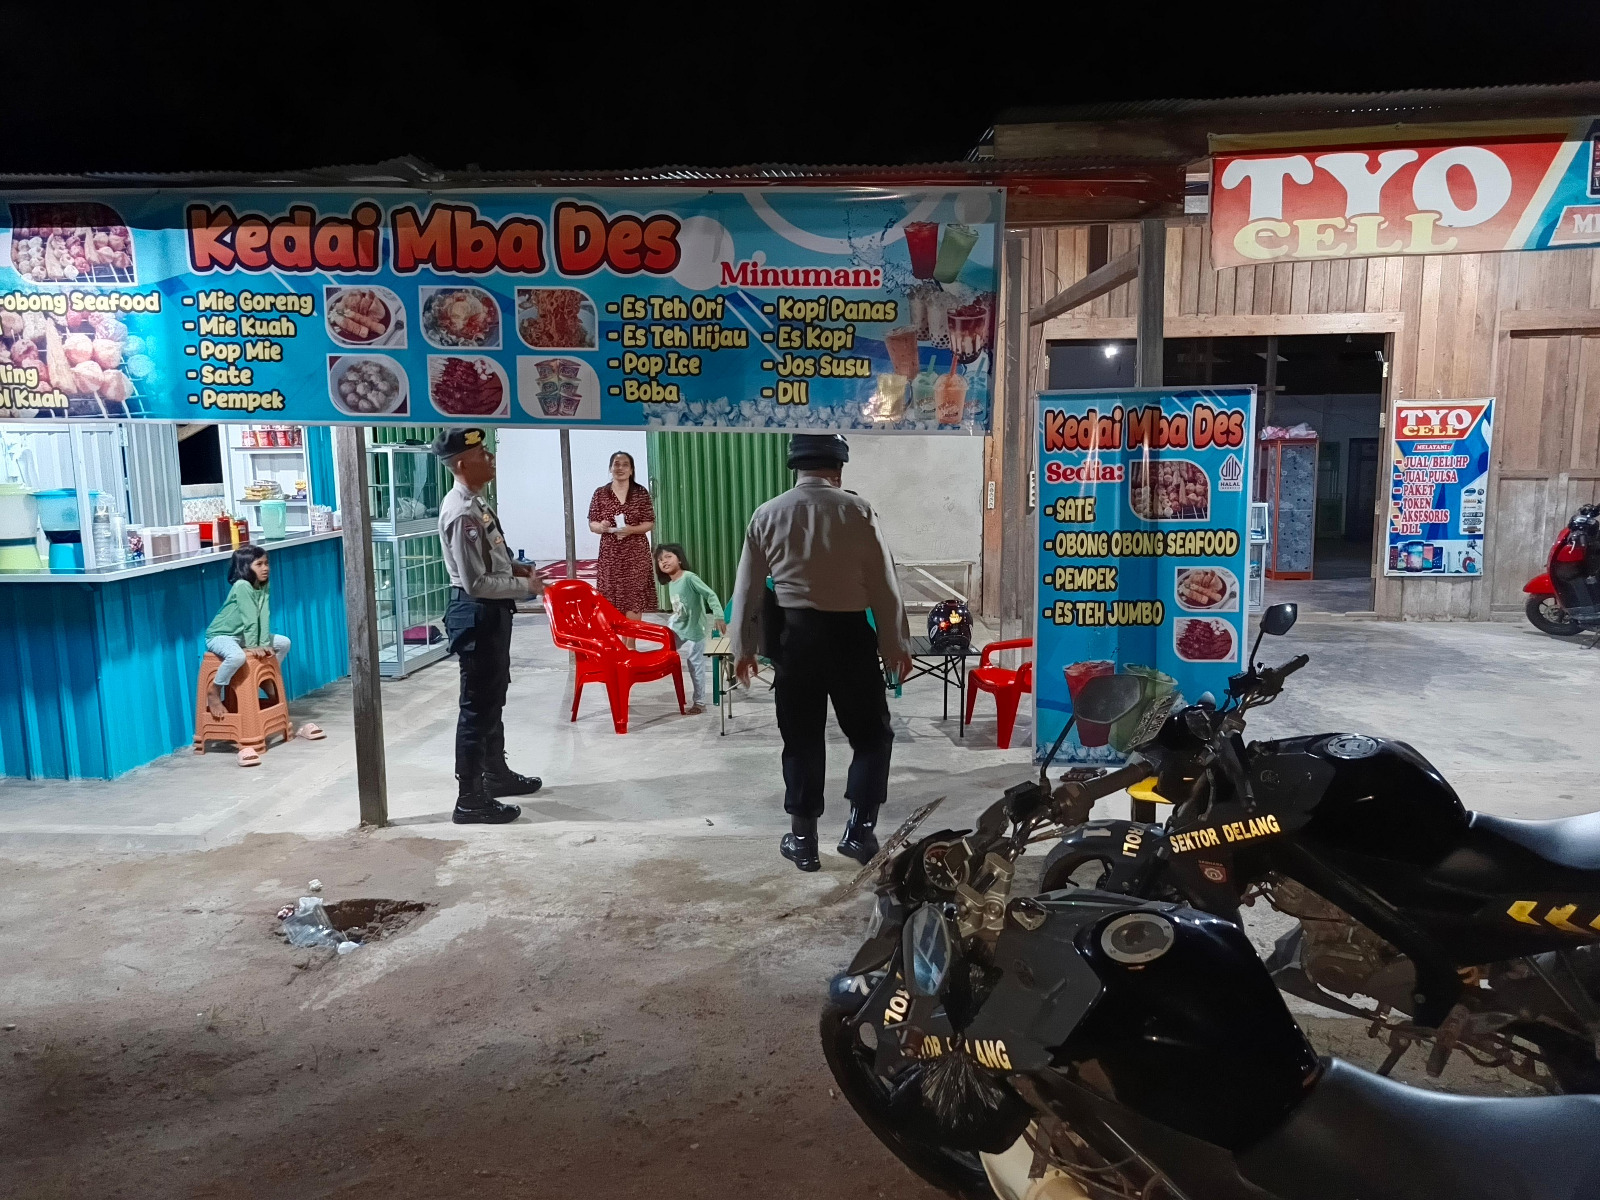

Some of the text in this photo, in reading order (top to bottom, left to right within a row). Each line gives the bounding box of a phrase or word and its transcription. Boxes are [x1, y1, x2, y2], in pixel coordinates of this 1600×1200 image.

[1221, 146, 1512, 236] TYO
[188, 202, 682, 274] Kedai Mba Des
[1233, 213, 1458, 260] CELL
[720, 261, 881, 288] Minuman:
[0, 291, 161, 315] obong Seafood
[198, 290, 314, 316] Mie Goreng
[622, 295, 724, 319] Es Teh Ori
[778, 297, 897, 323] Kopi Panas
[199, 315, 296, 336] Mie Kuah
[623, 324, 748, 350] Es Teh Hijau
[777, 324, 855, 352] Es Kopi
[200, 339, 282, 363] Pop Mie
[200, 365, 252, 384] Sate
[623, 352, 701, 377] Pop Ice
[777, 354, 871, 377] Jos Susu
[14, 388, 69, 408] Kuah
[201, 388, 285, 411] Pempek
[624, 379, 679, 402] Boba
[1044, 403, 1244, 452] Kedai Mba Des
[1400, 408, 1473, 430] TYO
[1402, 424, 1459, 436] CELL
[1046, 461, 1124, 482] Sedia:
[1455, 455, 1470, 468] HP
[1403, 470, 1458, 483] JUAL PULSA
[1402, 484, 1435, 496] PAKET
[1055, 498, 1095, 521] SATE
[1402, 497, 1433, 510] TOKEN
[1401, 510, 1450, 523] AKSESORIS
[1400, 523, 1421, 535] DLL
[1055, 530, 1239, 556] OBONG OBONG SEAFOOD
[1055, 566, 1118, 590] PEMPEK
[1054, 600, 1164, 625] ES TEH JUMBO
[1169, 814, 1281, 854] SEKTOR DELANG
